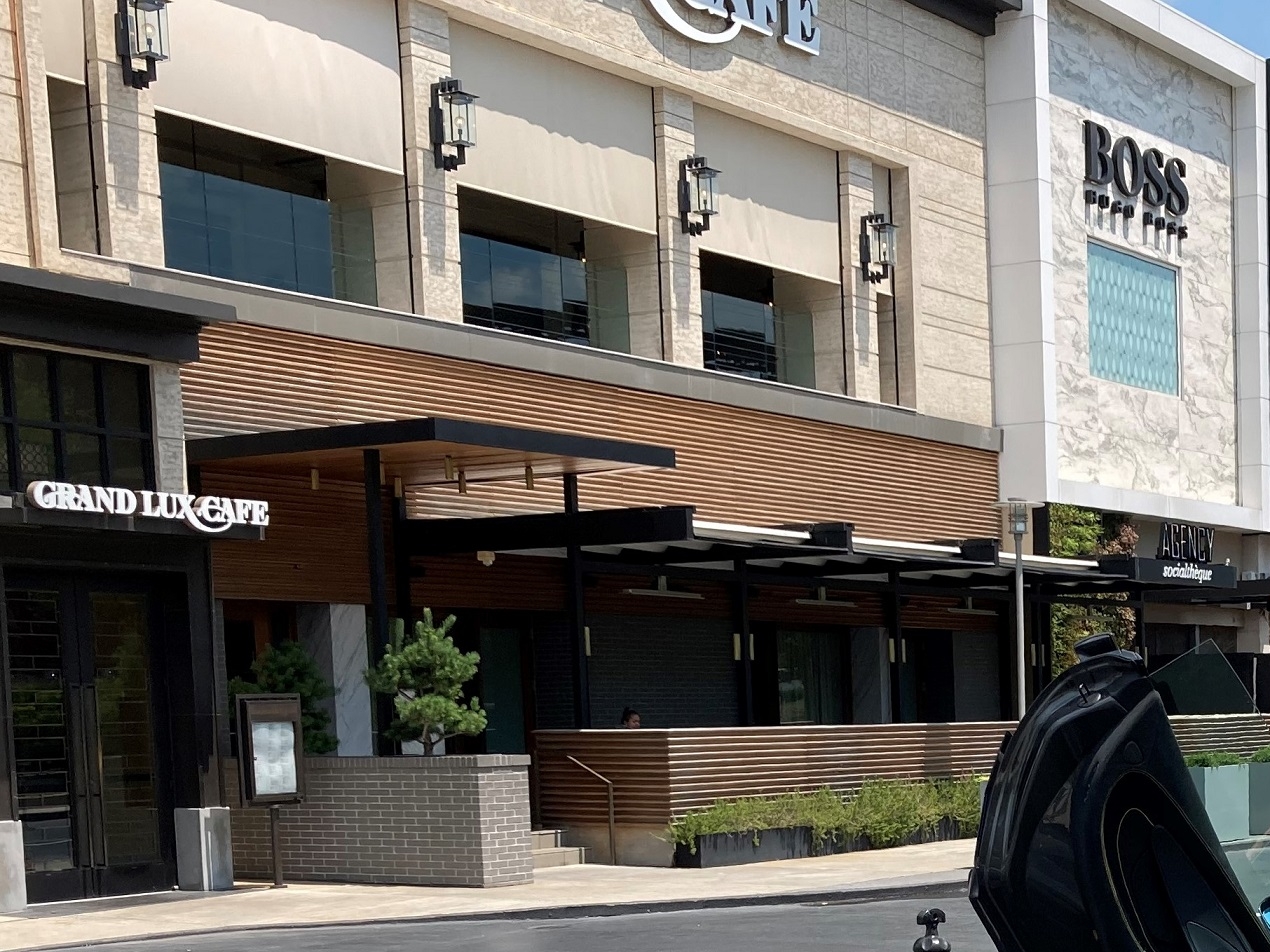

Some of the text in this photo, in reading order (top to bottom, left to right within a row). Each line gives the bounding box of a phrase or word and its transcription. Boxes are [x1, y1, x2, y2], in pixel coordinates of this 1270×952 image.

[1083, 119, 1189, 216] BOSS
[1085, 190, 1188, 239] HUGO BOSS
[32, 480, 138, 515] GRAND
[199, 495, 270, 527] CAFE
[1162, 522, 1215, 561] AGENCY
[1162, 562, 1213, 584] socialthèque
